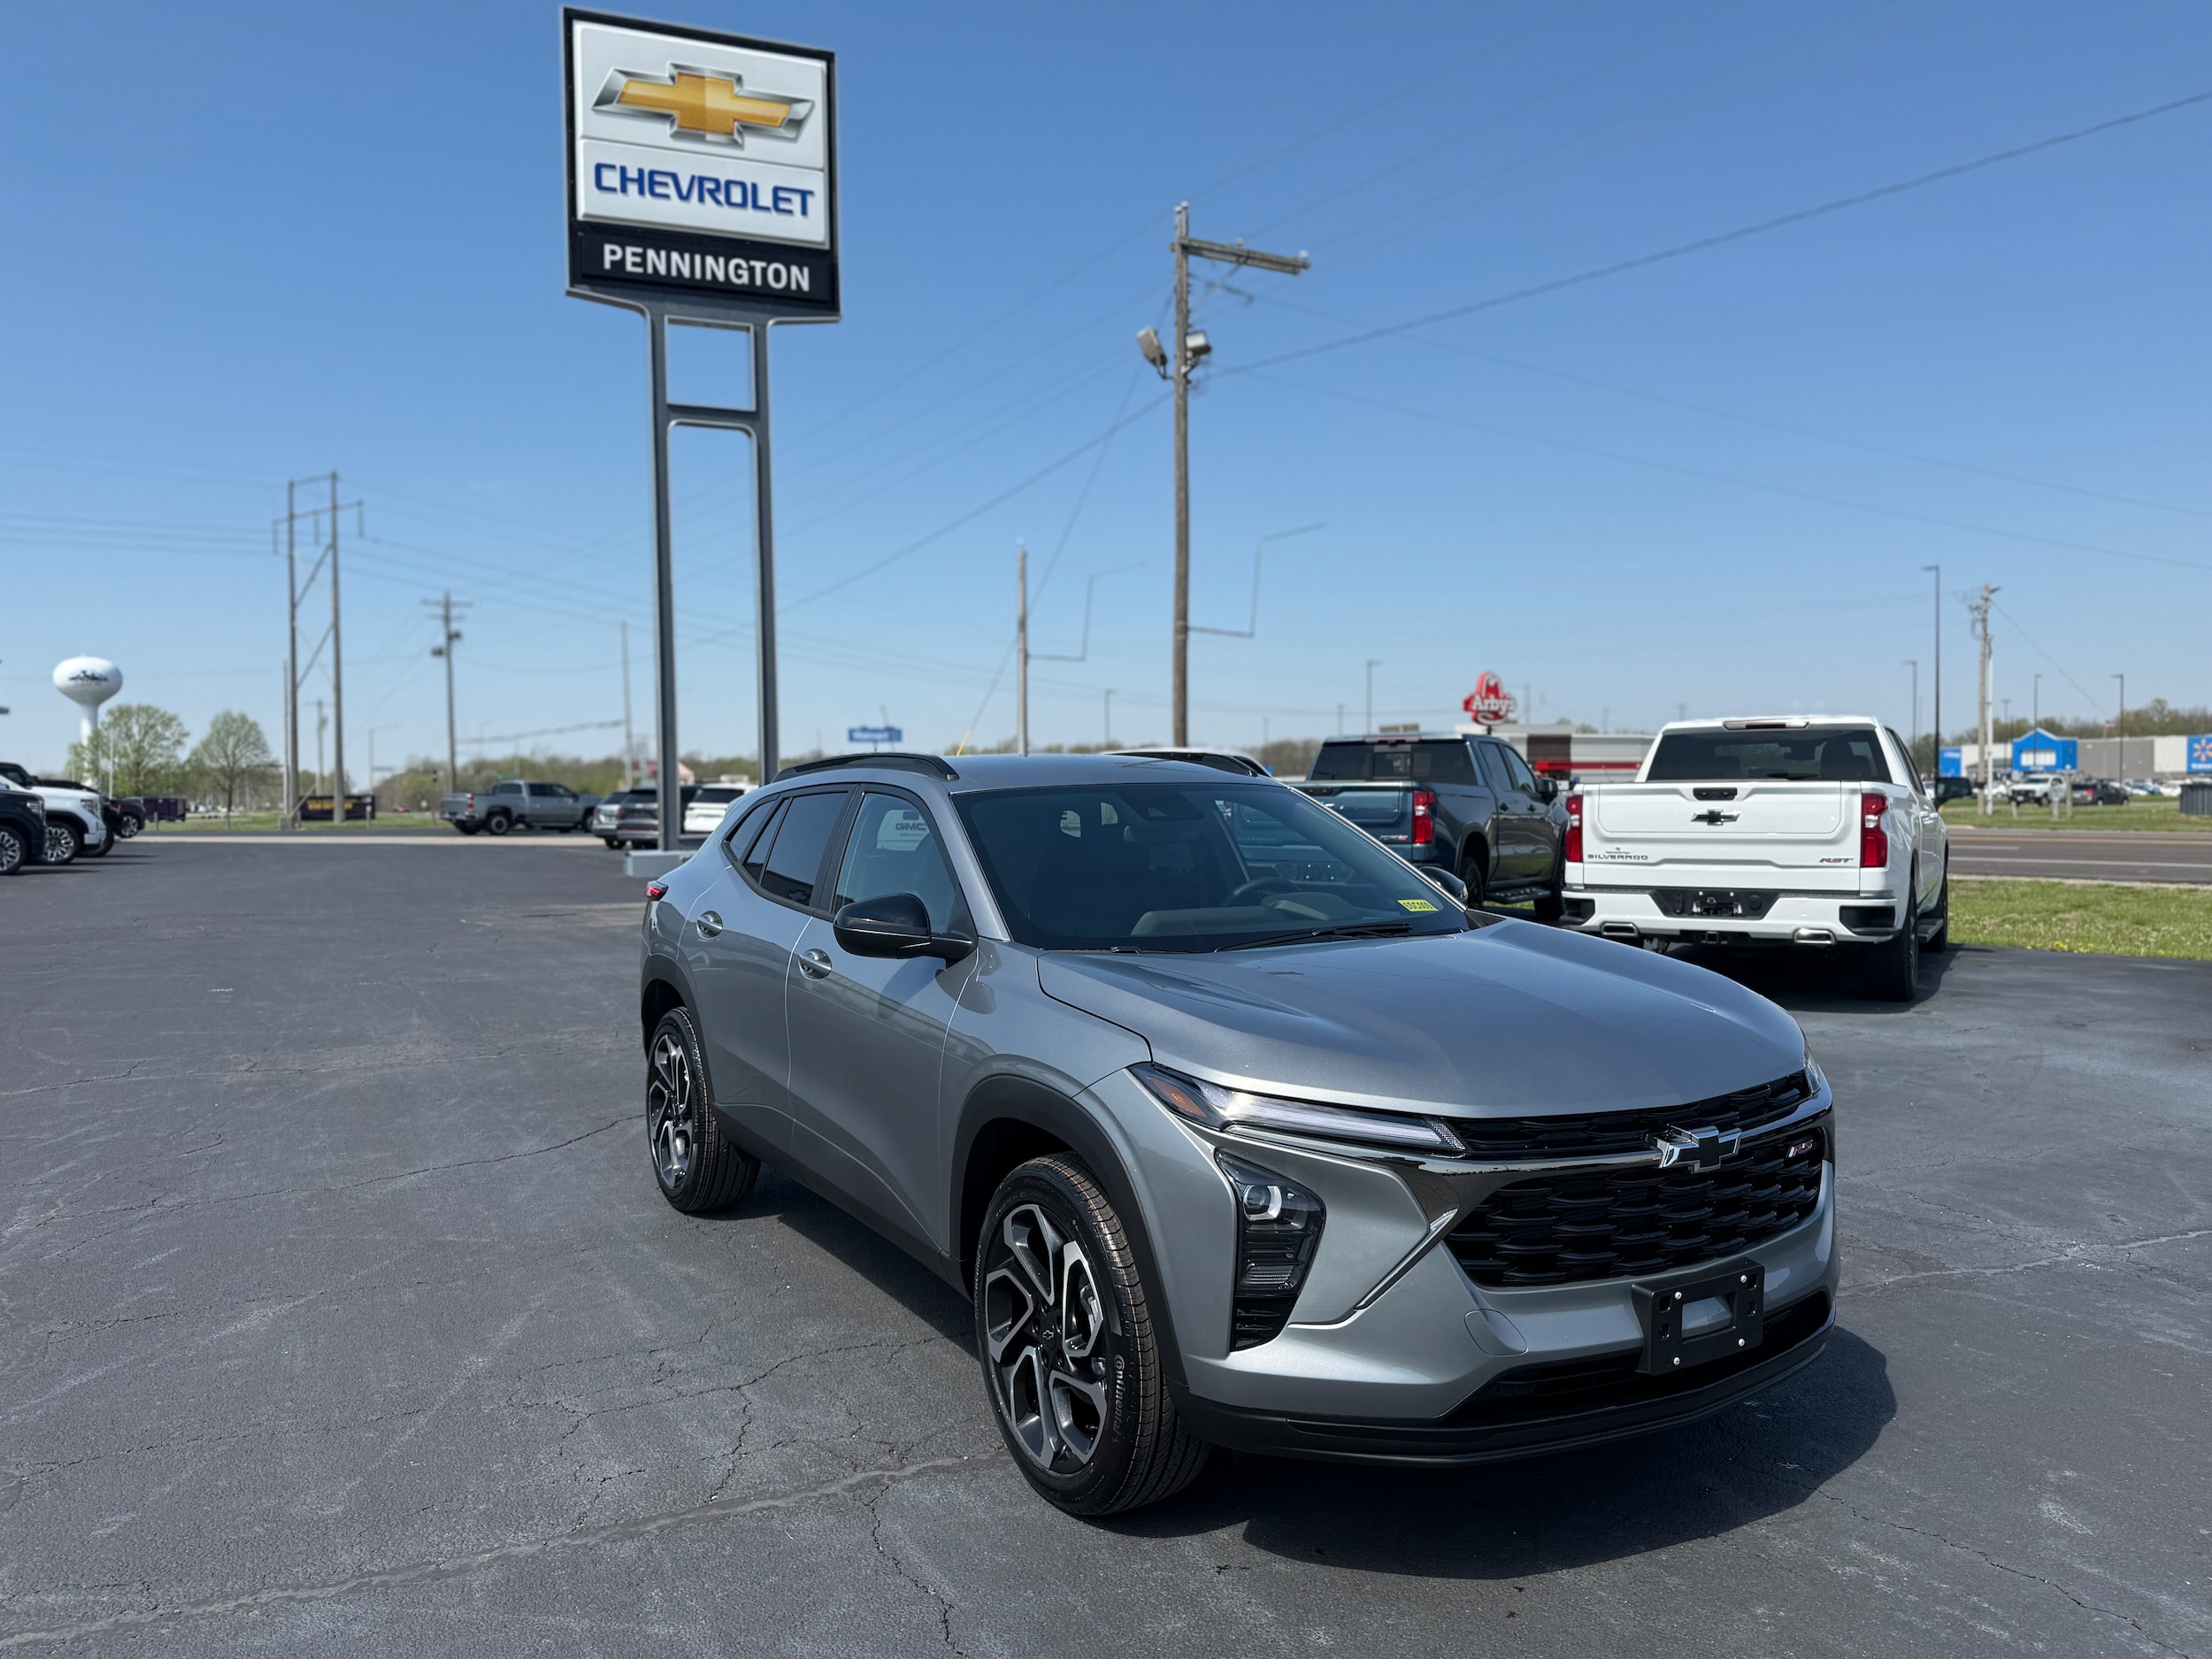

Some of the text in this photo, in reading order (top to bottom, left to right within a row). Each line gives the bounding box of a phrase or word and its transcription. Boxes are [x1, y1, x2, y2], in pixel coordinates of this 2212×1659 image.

[594, 162, 815, 218] CHEVROLET
[603, 242, 810, 292] PENNINGTON
[1112, 1354, 1126, 1435] Continental
